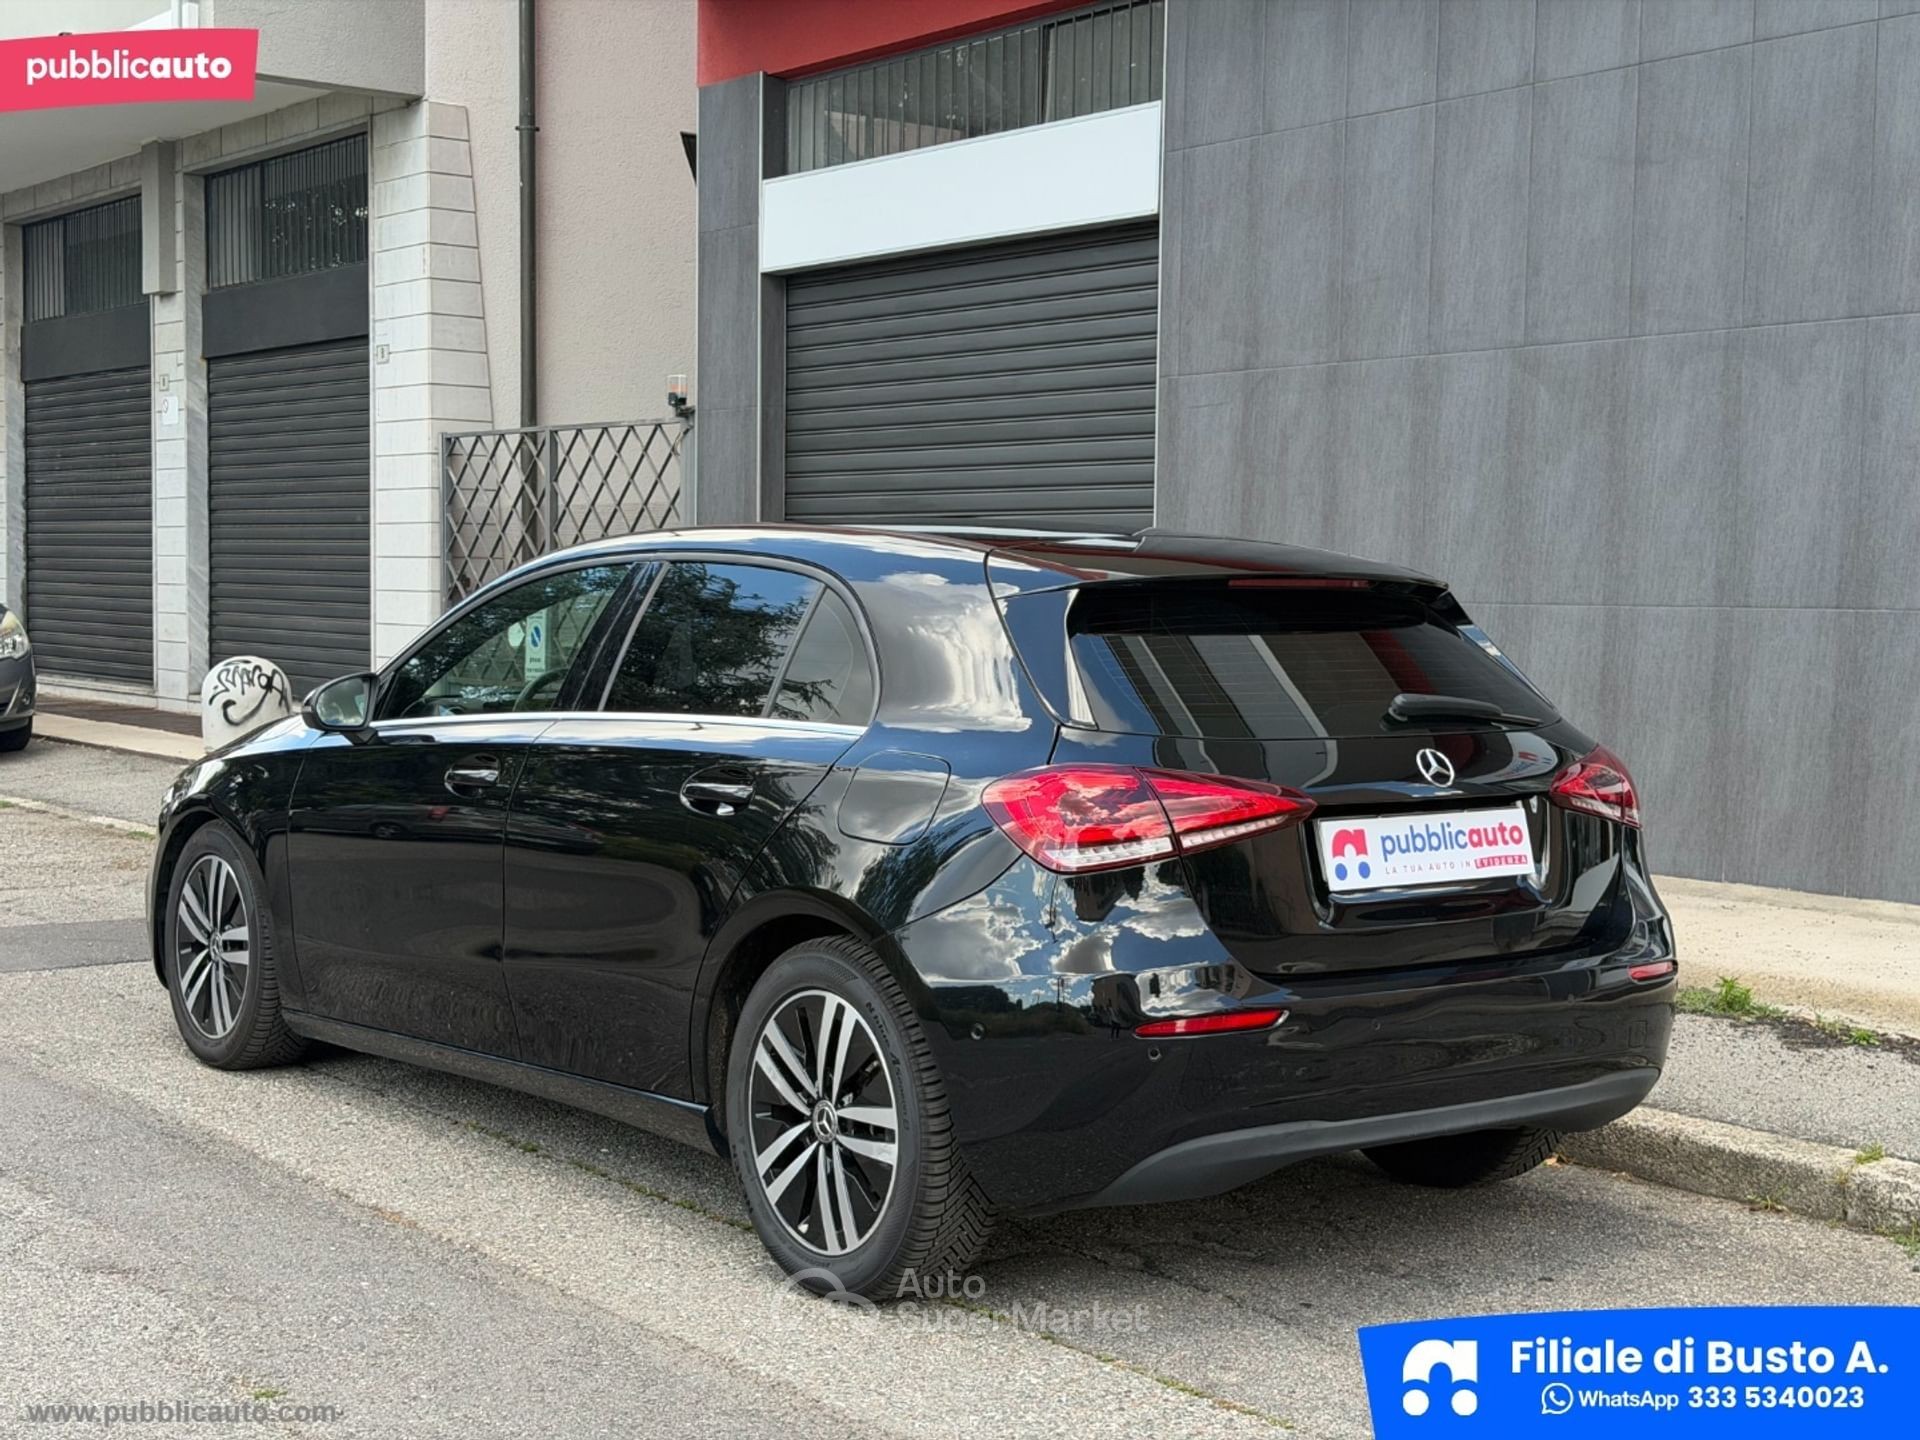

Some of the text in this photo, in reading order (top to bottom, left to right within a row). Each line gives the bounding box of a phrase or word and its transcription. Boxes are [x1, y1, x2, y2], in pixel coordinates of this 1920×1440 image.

[1381, 822, 1523, 862] pubblicauto
[1385, 867, 1397, 875] LA
[1403, 865, 1423, 874] TUA
[1429, 861, 1455, 871] AUTO
[1461, 860, 1471, 868] IN
